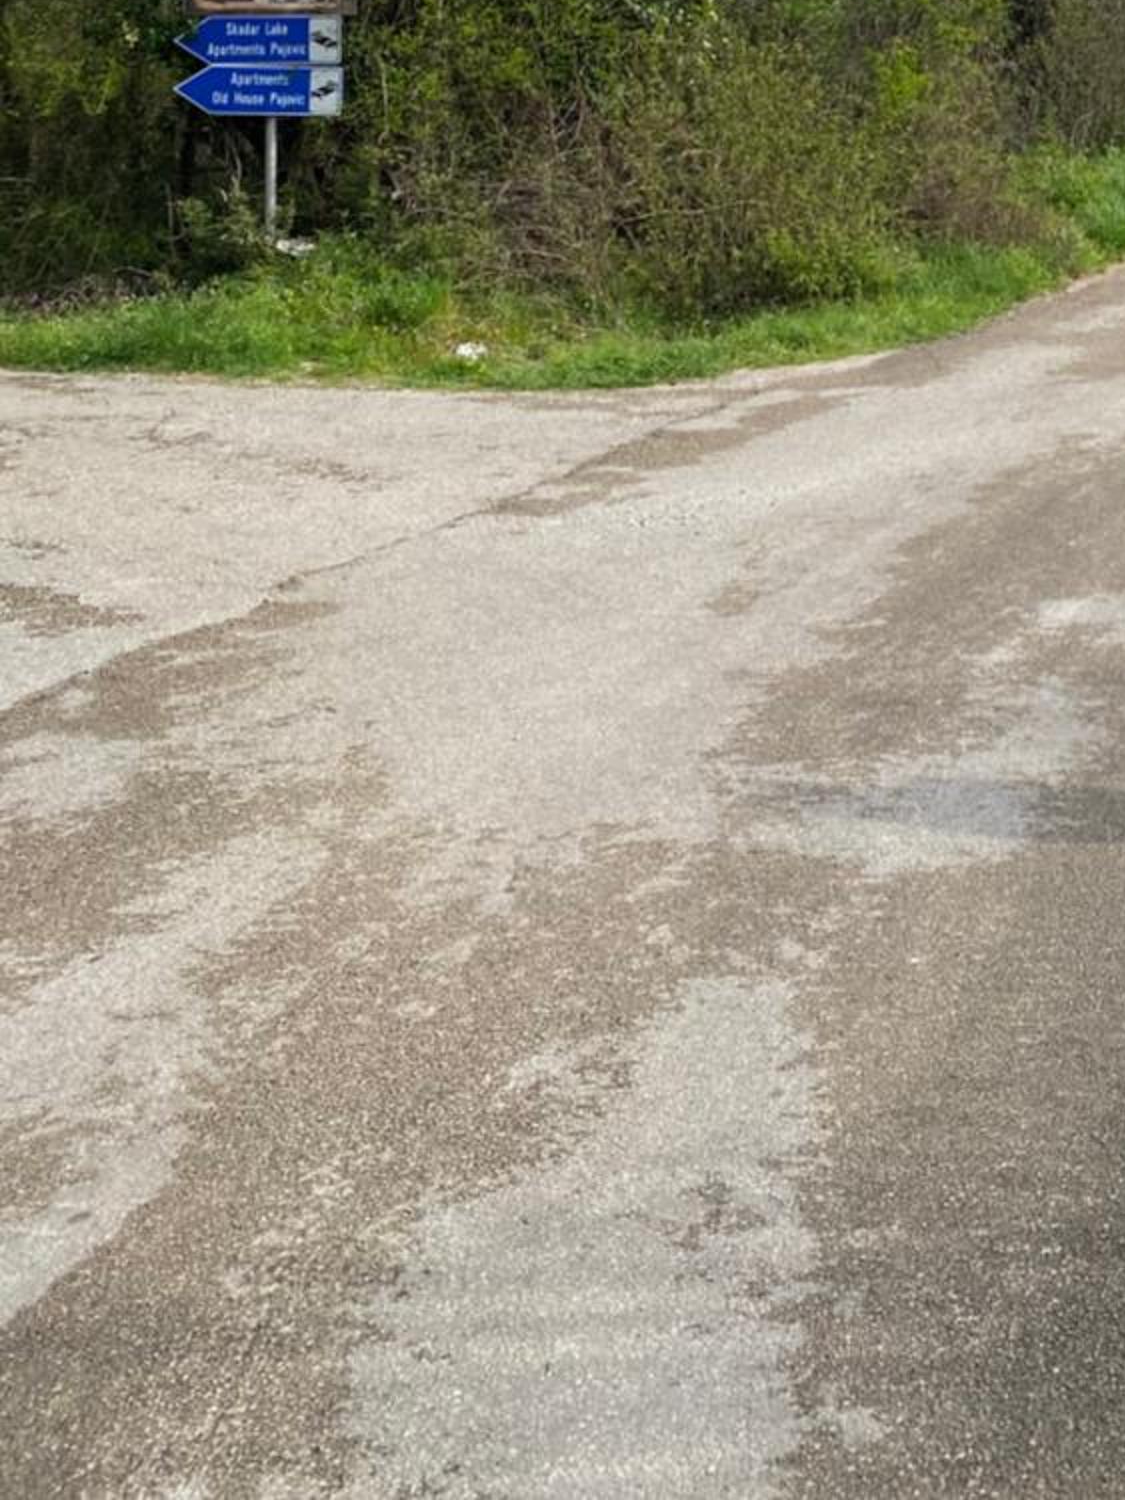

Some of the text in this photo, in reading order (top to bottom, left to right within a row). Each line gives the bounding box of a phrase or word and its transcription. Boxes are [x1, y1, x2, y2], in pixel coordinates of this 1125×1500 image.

[226, 22, 288, 36] Skadar Lake
[207, 43, 266, 57] Apartments
[231, 72, 289, 87] Apartments
[212, 92, 229, 104] Old
[234, 92, 264, 105] House
